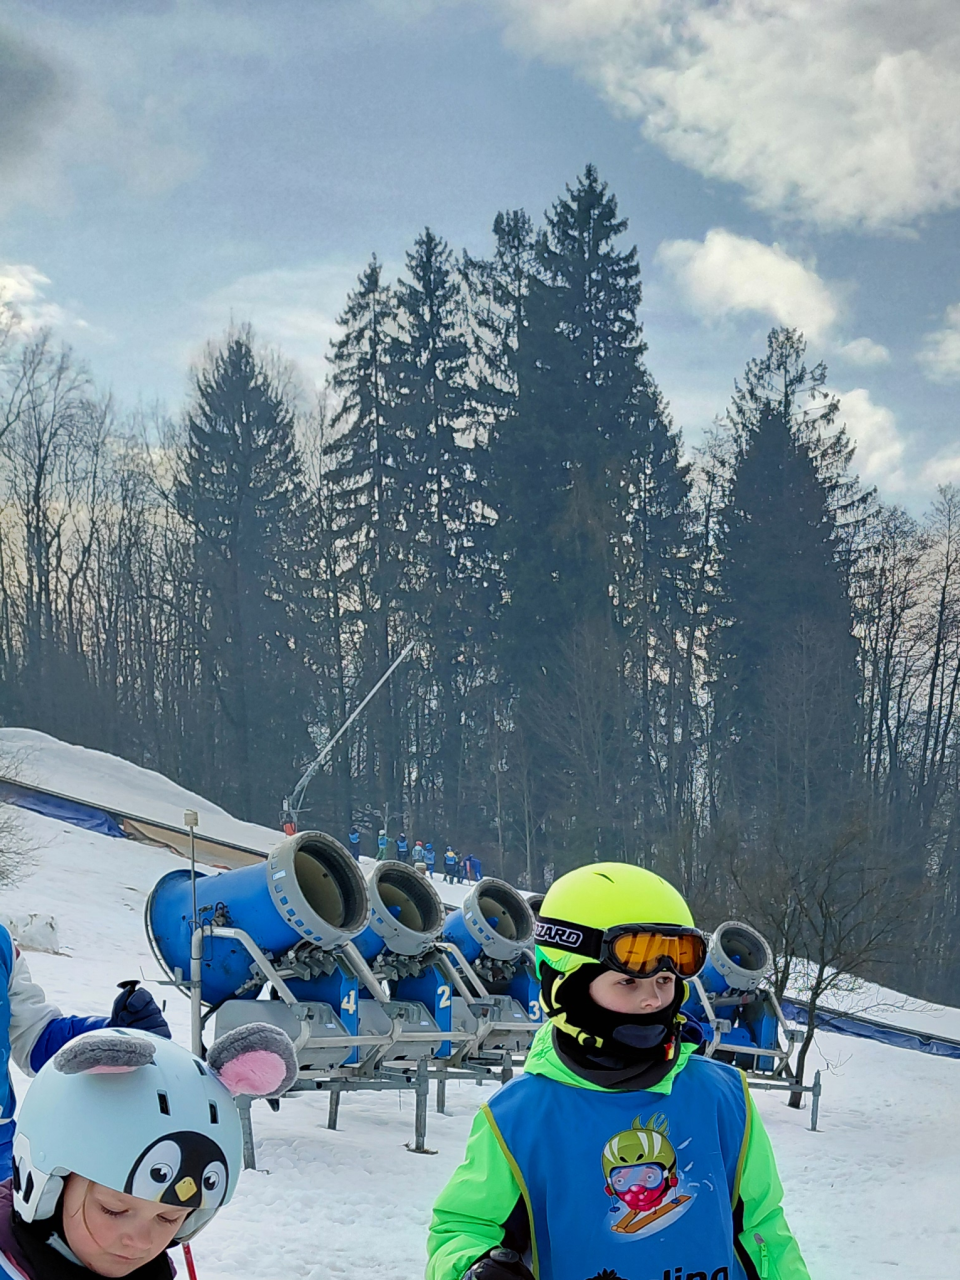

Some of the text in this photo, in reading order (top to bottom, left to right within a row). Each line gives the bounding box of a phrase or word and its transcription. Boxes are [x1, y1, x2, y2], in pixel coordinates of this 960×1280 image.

[341, 990, 356, 1014] 4
[437, 985, 450, 1008] 2
[529, 1001, 541, 1020] 3
